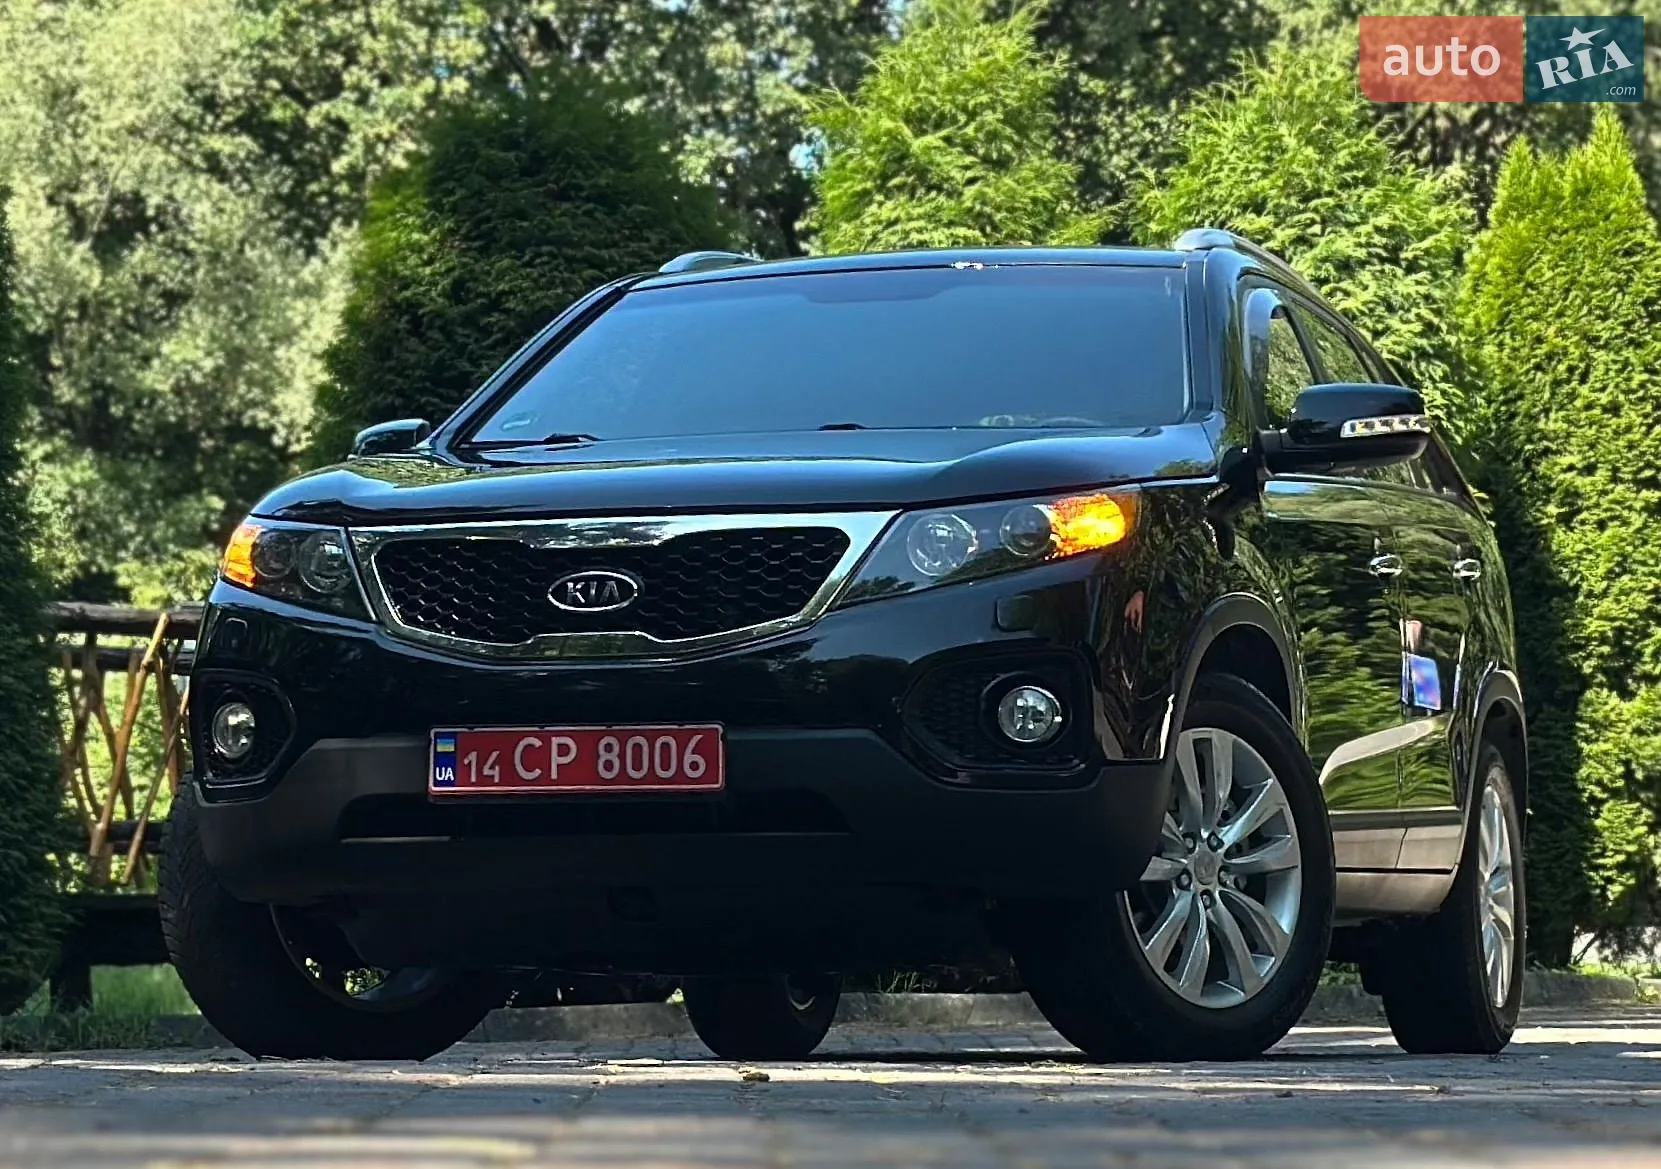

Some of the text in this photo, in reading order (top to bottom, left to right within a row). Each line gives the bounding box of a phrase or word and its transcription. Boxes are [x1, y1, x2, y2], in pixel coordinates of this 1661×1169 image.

[566, 581, 620, 603] KIA
[463, 734, 706, 783] 14 CP 8006
[435, 767, 454, 781] UA
